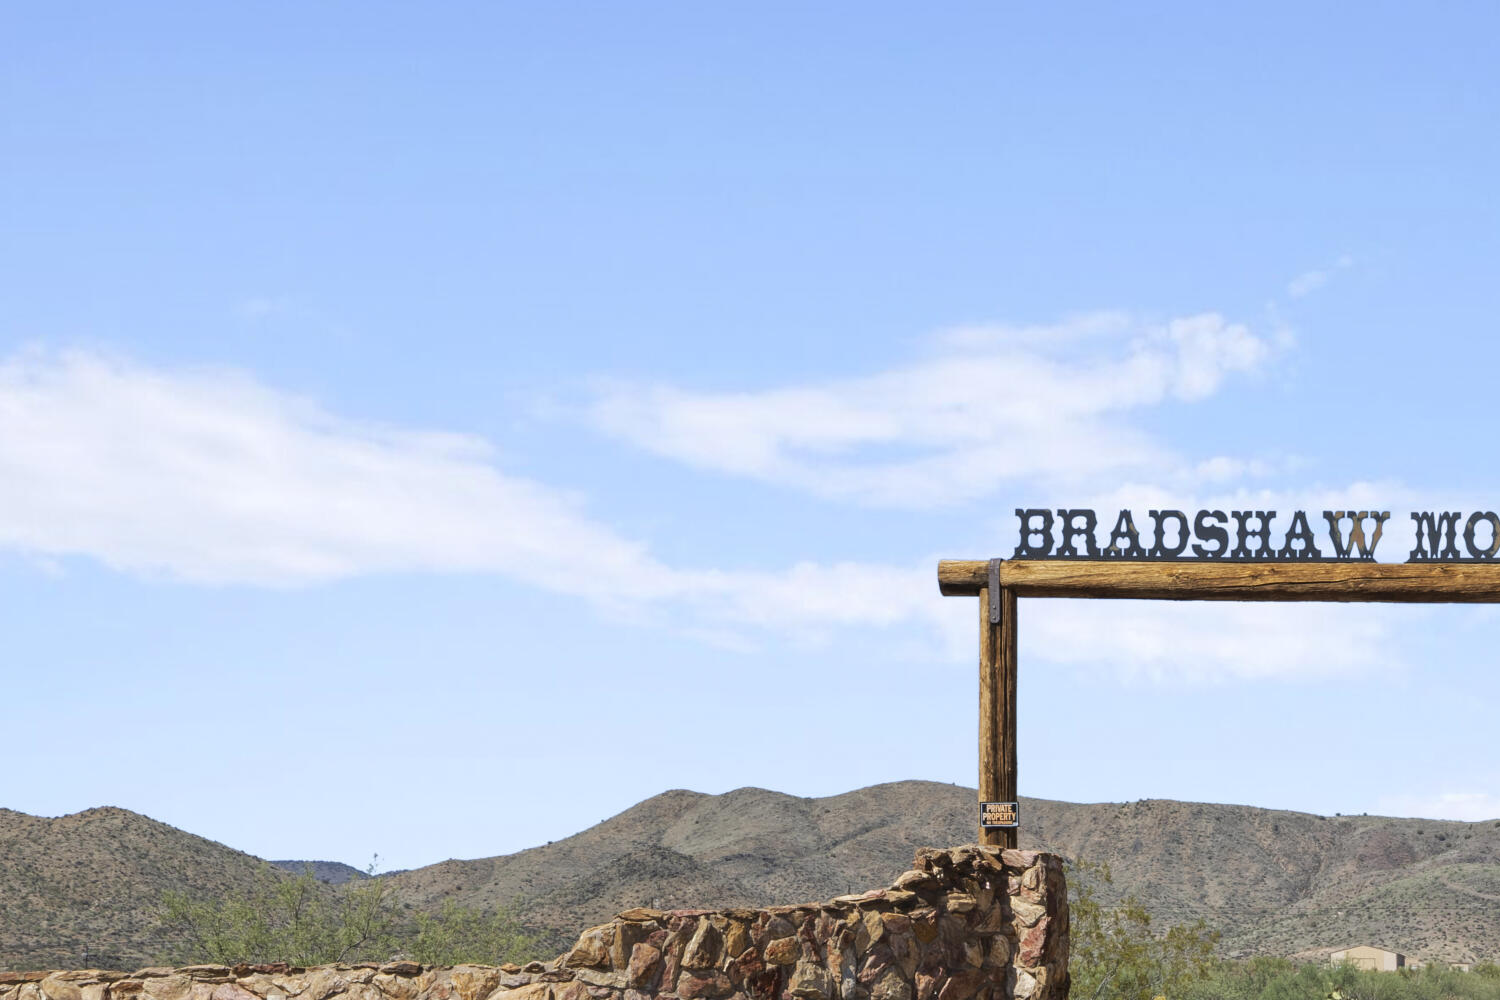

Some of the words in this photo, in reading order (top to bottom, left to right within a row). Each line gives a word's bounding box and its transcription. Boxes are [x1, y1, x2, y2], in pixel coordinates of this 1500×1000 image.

[1015, 509, 1390, 558] BRADSHAW
[986, 804, 1013, 813] PRIVATE
[982, 812, 1016, 821] PROPERTY
